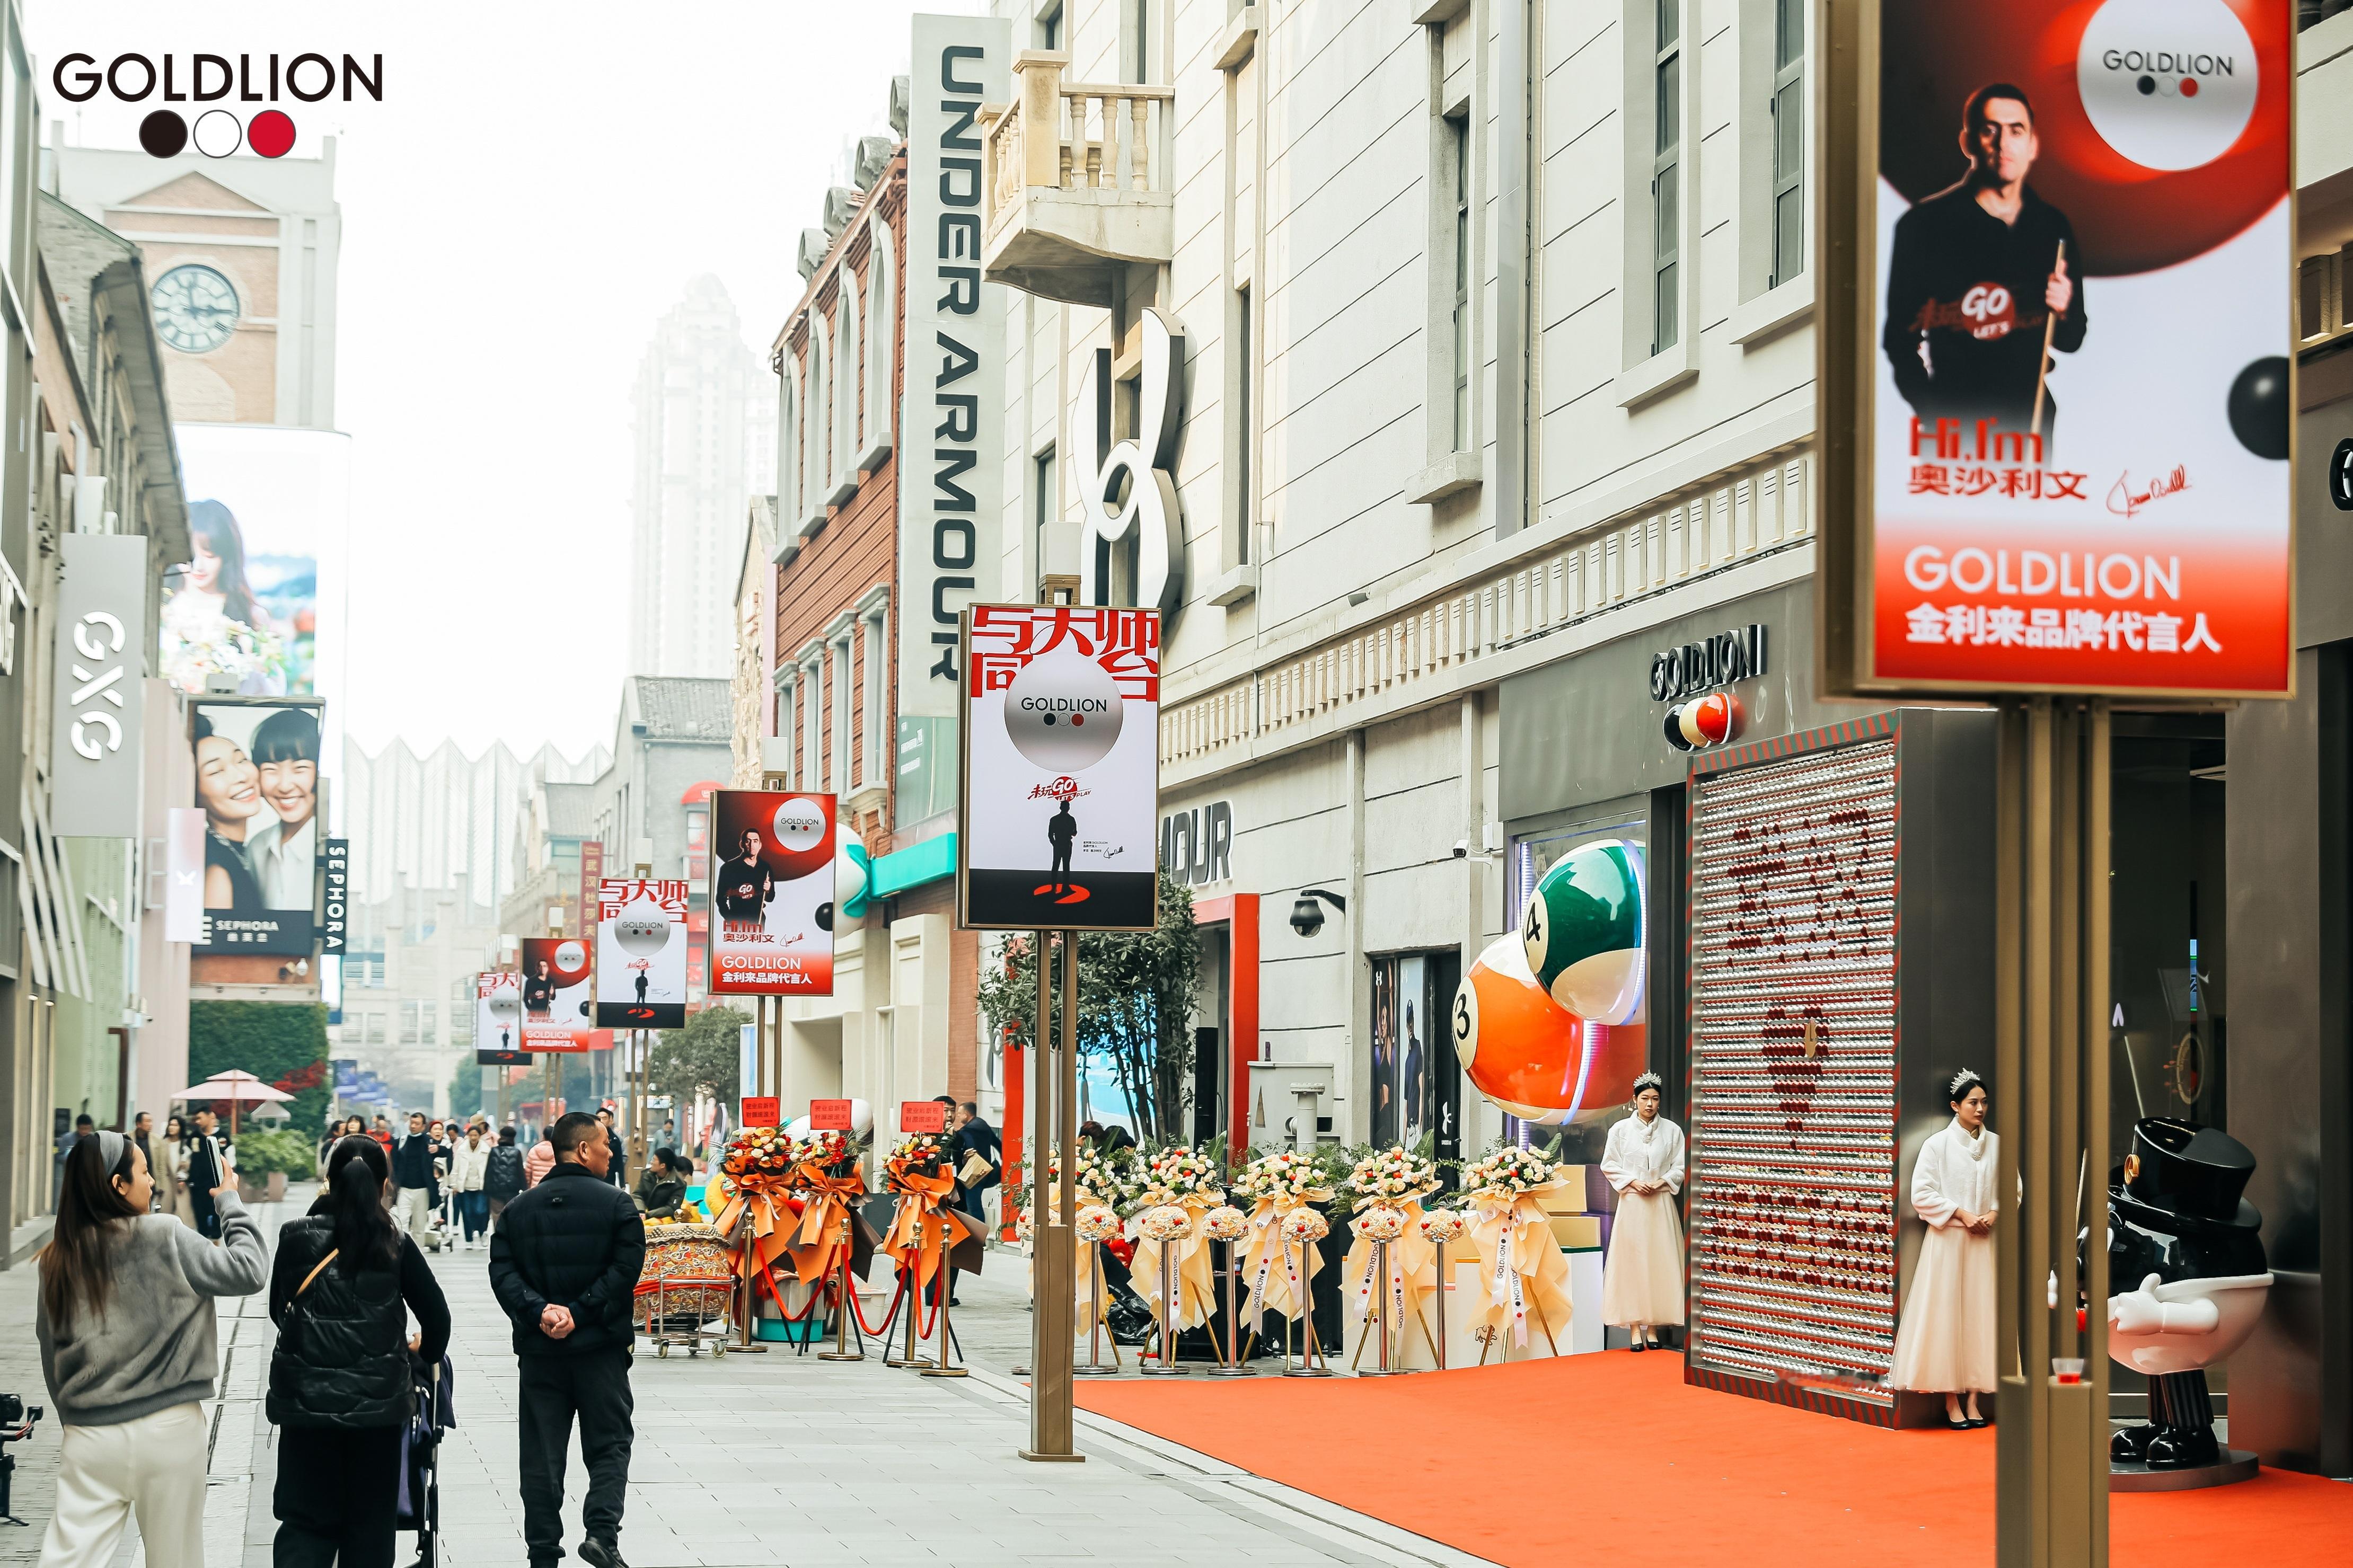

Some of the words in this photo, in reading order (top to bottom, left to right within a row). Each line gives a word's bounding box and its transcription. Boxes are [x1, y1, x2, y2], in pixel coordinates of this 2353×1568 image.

[2103, 50, 2232, 76] GOLDLION
[937, 46, 984, 315] UNDER
[1961, 286, 2009, 321] GO
[1907, 463, 2087, 500] 奥沙利文
[930, 330, 979, 682] ARMOUR
[1905, 545, 2180, 600] GOLDLION
[1906, 603, 2222, 654] 金利来品牌代言人
[1649, 624, 1761, 702] GOLDLION
[70, 610, 126, 760] GXG
[1020, 697, 1107, 713] GOLDLION
[326, 847, 346, 948] SEPHORA
[739, 884, 753, 894] GO
[216, 920, 279, 931] SEPHORA
[722, 933, 774, 943] 奥沙利文
[1526, 902, 1541, 942] 4
[721, 955, 801, 970] GOLDLION
[721, 971, 813, 985] 金利来品牌代言人
[1455, 993, 1470, 1040] 3
[525, 1030, 571, 1039] GOLDLION
[1366, 1244, 1379, 1278] GOLDLION
[1497, 1245, 1506, 1279] GOLDLION
[1254, 1275, 1264, 1308] GOLDLION
[1396, 1295, 1404, 1328] GOLDLION
